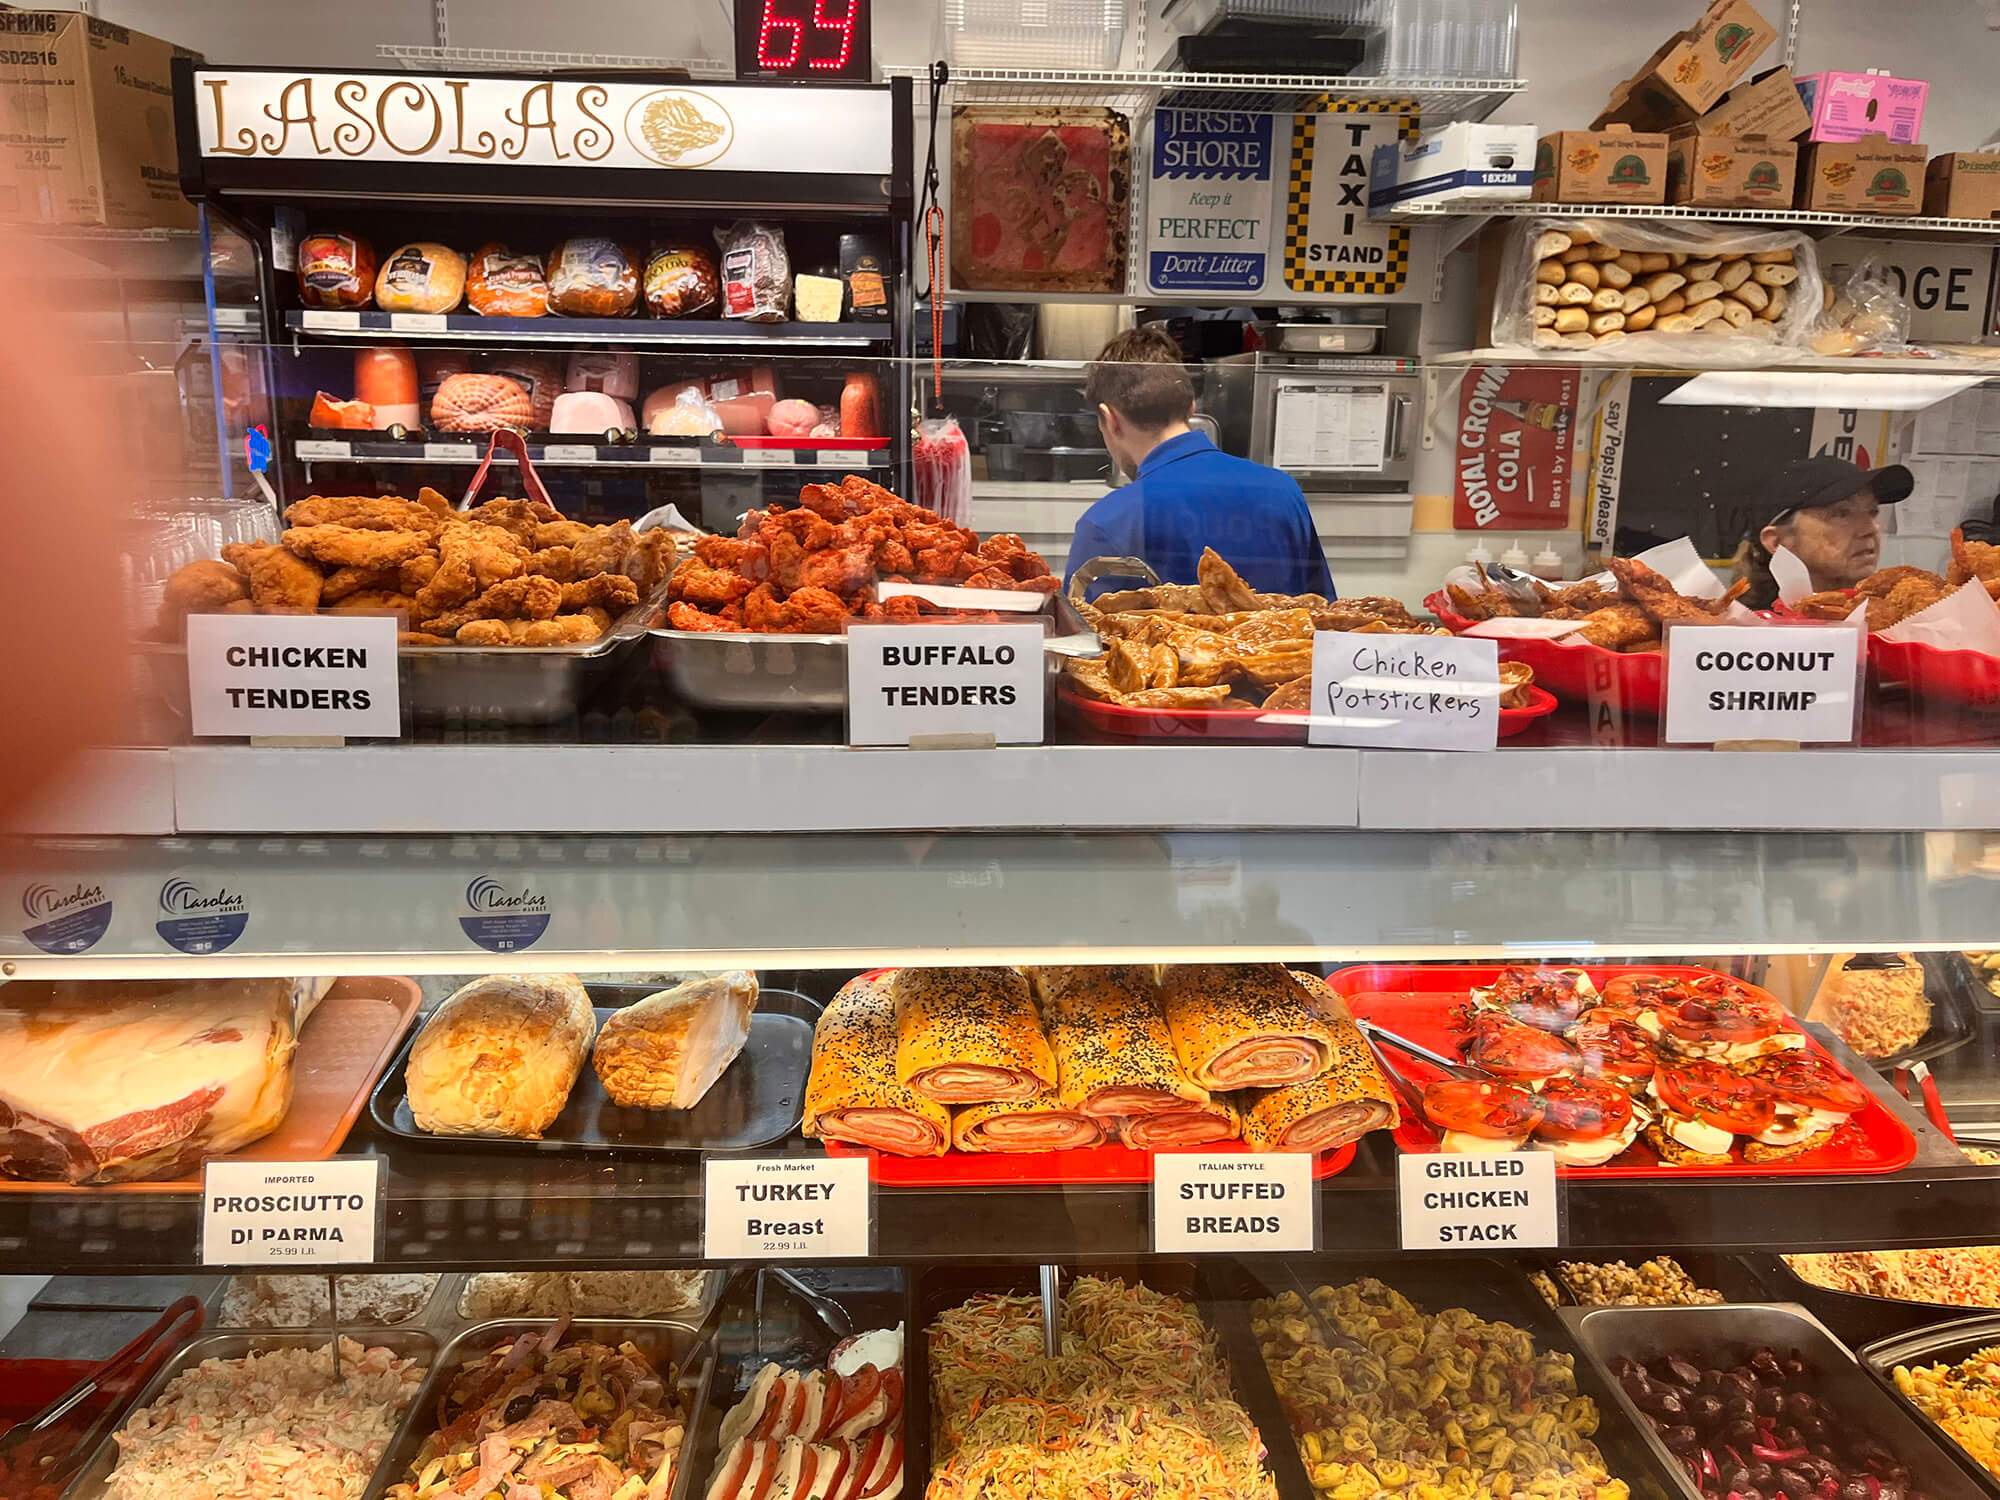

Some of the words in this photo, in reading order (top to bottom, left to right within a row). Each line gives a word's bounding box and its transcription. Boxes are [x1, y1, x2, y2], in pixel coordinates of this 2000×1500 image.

[757, 0, 858, 70] 69
[203, 77, 615, 161] LASOLAS
[1170, 111, 1260, 138] JERSEY
[1163, 140, 1262, 168] SHORE
[1337, 123, 1370, 235] TAXI
[1481, 173, 1517, 184] 18X2M
[1189, 192, 1221, 208] Keep
[1223, 193, 1232, 206] it
[1159, 218, 1260, 239] PERFECT
[1308, 244, 1383, 264] STAND
[1163, 255, 1208, 273] Don't
[1208, 256, 1257, 274] Litter
[1461, 366, 1511, 448] CROWN
[1604, 401, 1621, 431] say
[1497, 429, 1521, 492] COLA
[1552, 456, 1566, 474] by
[1461, 452, 1500, 527] ROYAL
[1549, 480, 1563, 508] Best
[226, 646, 367, 668] CHICKEN
[883, 645, 1015, 666] BUFFALO
[1695, 651, 1835, 672] COCONUT
[225, 688, 371, 710] TENDERS
[881, 685, 1016, 706] TENDERS
[1708, 691, 1817, 711] SHRIMP
[46, 884, 104, 912] Lasolas
[183, 888, 244, 910] Lasolas
[488, 888, 546, 907] Lasolas
[756, 1164, 781, 1172] Fresh
[784, 1163, 815, 1172] Market
[1199, 1163, 1234, 1171] ITALIAN
[1237, 1163, 1265, 1171] STYLE
[1426, 1160, 1524, 1178] GRILLED
[264, 1175, 315, 1184] IMPORTED
[735, 1184, 836, 1201] TURKEY
[1180, 1183, 1285, 1200] STUFFED
[1424, 1190, 1528, 1209] CHICKEN
[213, 1195, 364, 1213] PROSCIUTTO
[747, 1218, 824, 1236] Breast
[1186, 1217, 1280, 1233] BREADS
[1440, 1223, 1518, 1242] STACK
[231, 1229, 253, 1245] DI
[262, 1227, 344, 1242] PARMA
[763, 1242, 790, 1250] 22.99
[269, 1247, 298, 1256] 25.99
